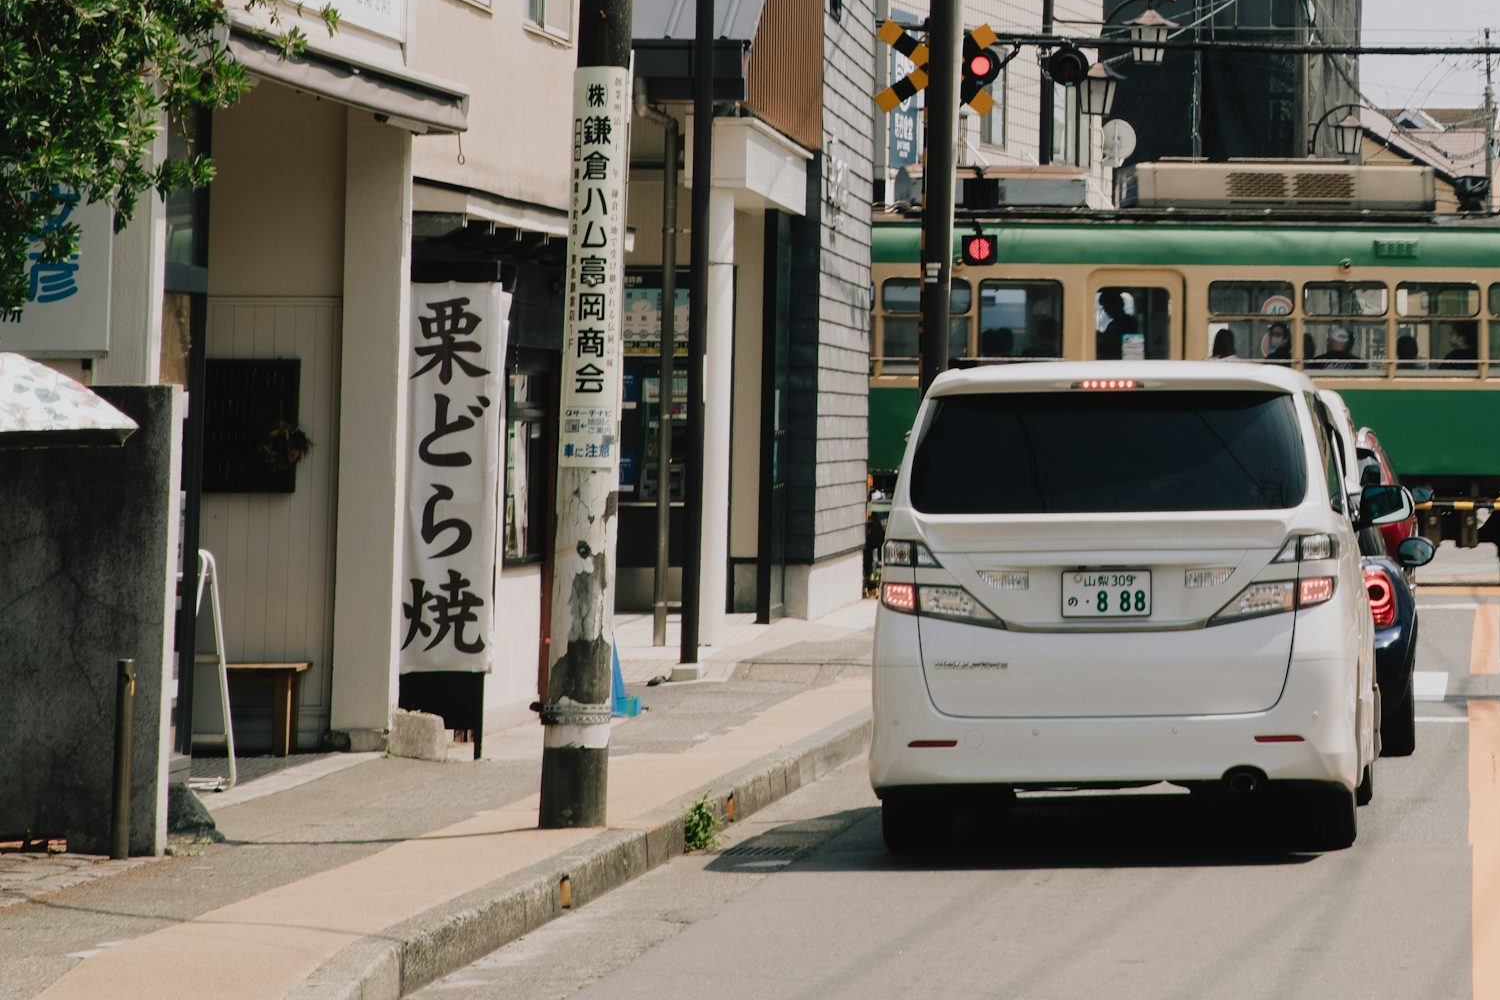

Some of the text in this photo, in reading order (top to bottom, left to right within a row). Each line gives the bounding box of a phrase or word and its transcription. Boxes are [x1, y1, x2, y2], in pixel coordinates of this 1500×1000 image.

[564, 443, 610, 458] 車に注意
[401, 297, 490, 656] 栗どら焼
[1084, 575, 1133, 587] 山梨 309
[1068, 596, 1078, 607] の
